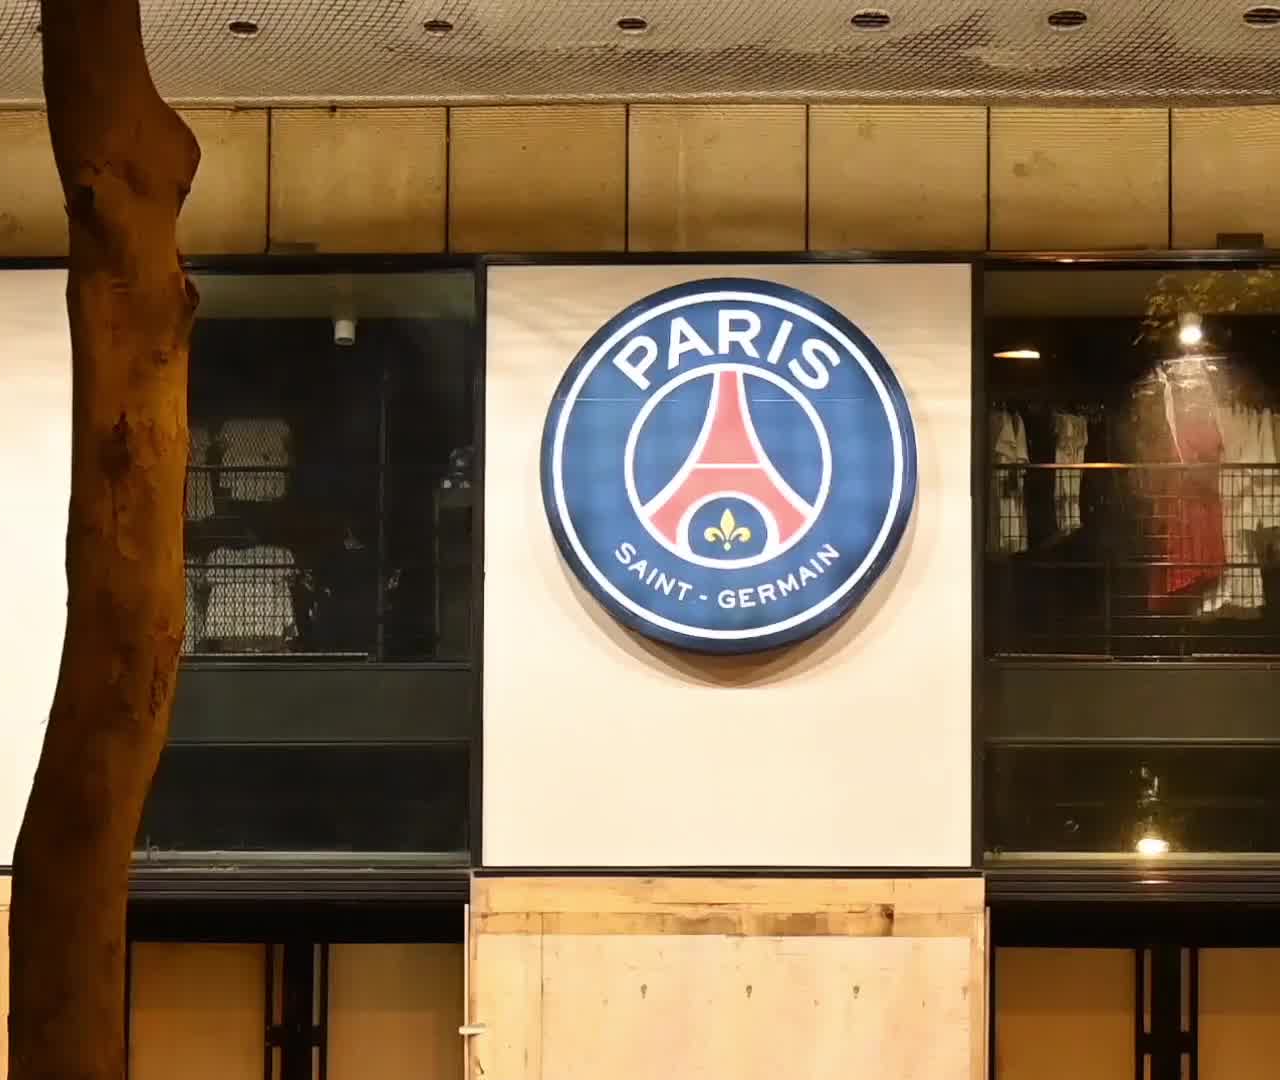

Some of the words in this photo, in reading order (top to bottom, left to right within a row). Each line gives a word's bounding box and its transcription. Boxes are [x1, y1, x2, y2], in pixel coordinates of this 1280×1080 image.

[612, 308, 841, 392] PARIS
[615, 542, 693, 602] SAINT
[717, 543, 842, 610] GERMAIN
